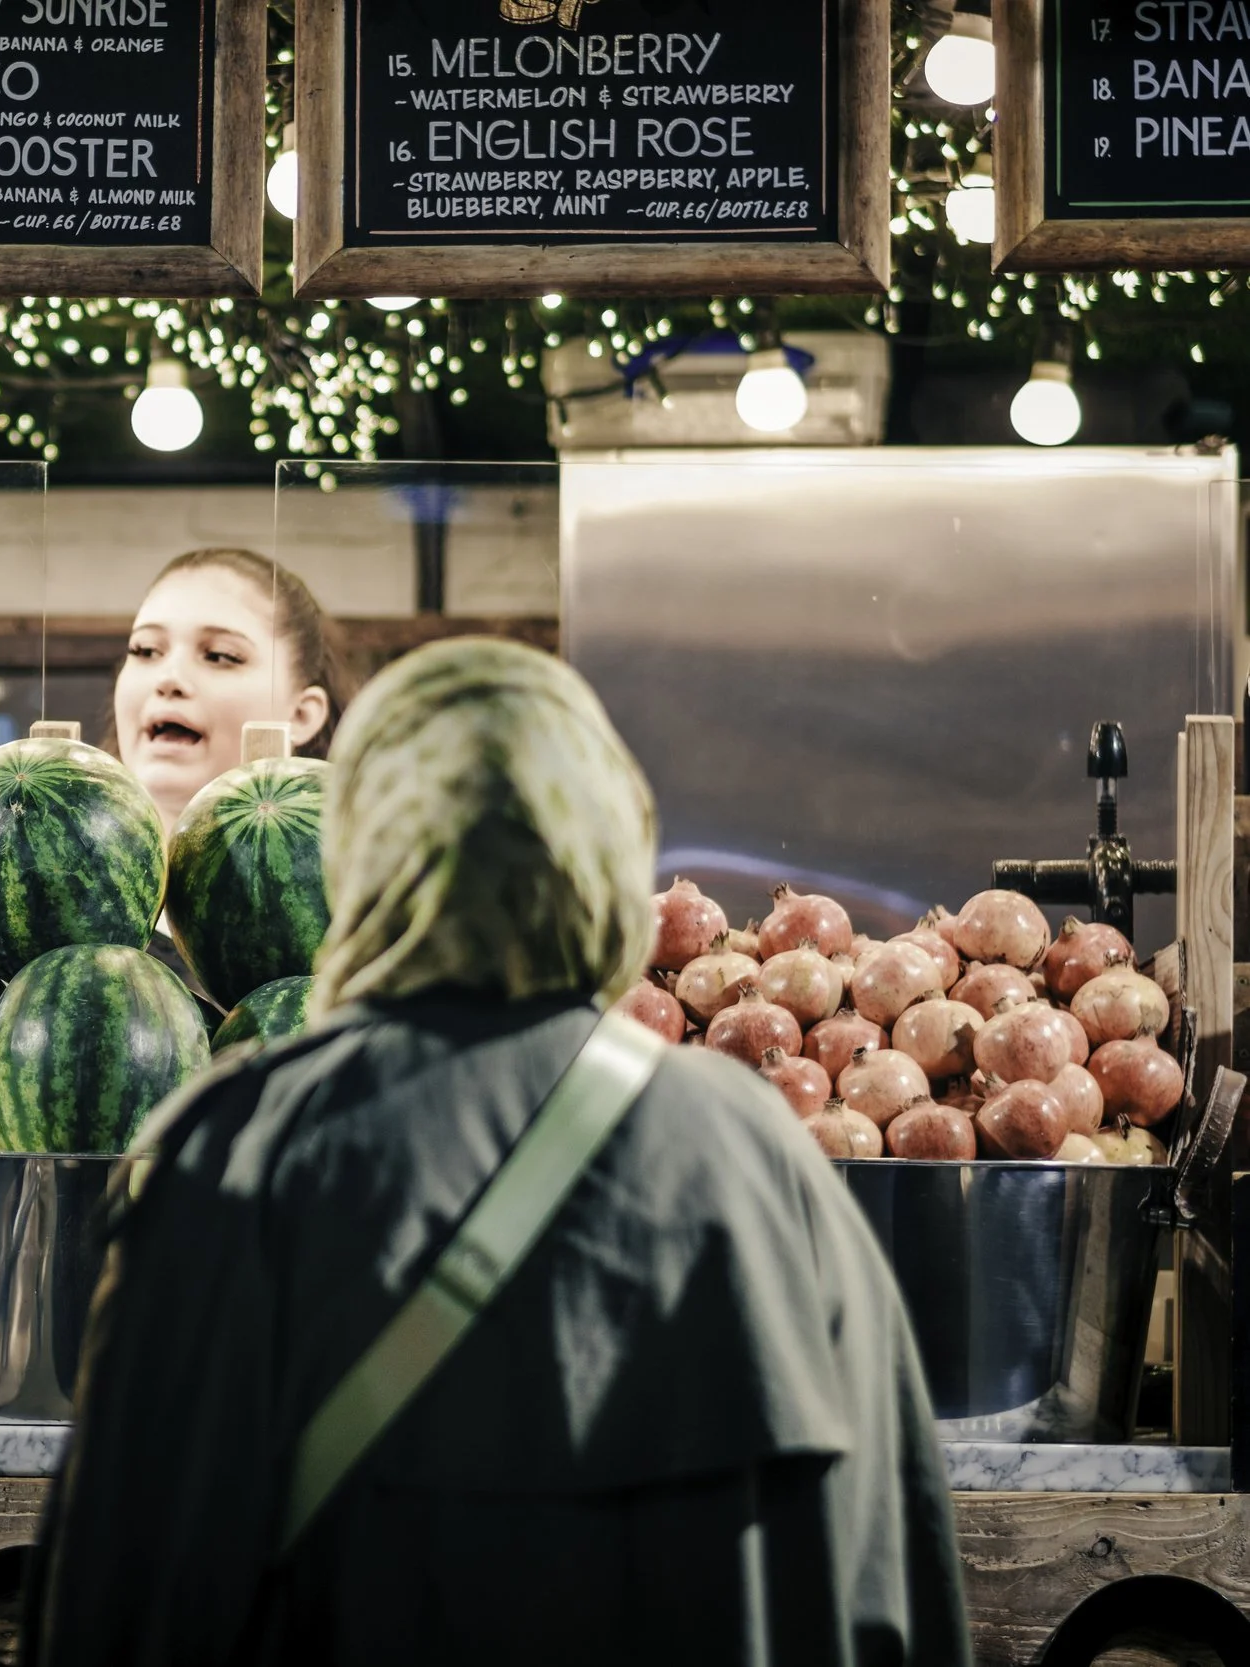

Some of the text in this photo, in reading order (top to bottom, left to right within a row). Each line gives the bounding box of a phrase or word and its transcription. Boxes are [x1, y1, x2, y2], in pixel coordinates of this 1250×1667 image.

[21, 0, 169, 28] SUNRISE
[0, 36, 68, 52] BANANA
[73, 35, 84, 54] &
[90, 37, 164, 53] ORANGE
[388, 32, 721, 79] 15. MELONBERRY
[1092, 58, 1250, 101] 18. BANA
[409, 83, 795, 111] WATERMELON & STRAWBERRY
[42, 111, 52, 129] &
[56, 112, 127, 127] COCONUT
[133, 113, 181, 129] MILK
[389, 116, 755, 163] 16. ENGLISH ROSE
[1094, 115, 1250, 159] 19. PINEA
[407, 166, 810, 194] STRAWBERRY, RASPBERRY, APPLE,
[69, 186, 79, 206] &
[87, 188, 156, 206] ALMOND
[158, 189, 196, 206] MILK
[407, 193, 611, 220] BLUEBERRY, MINT
